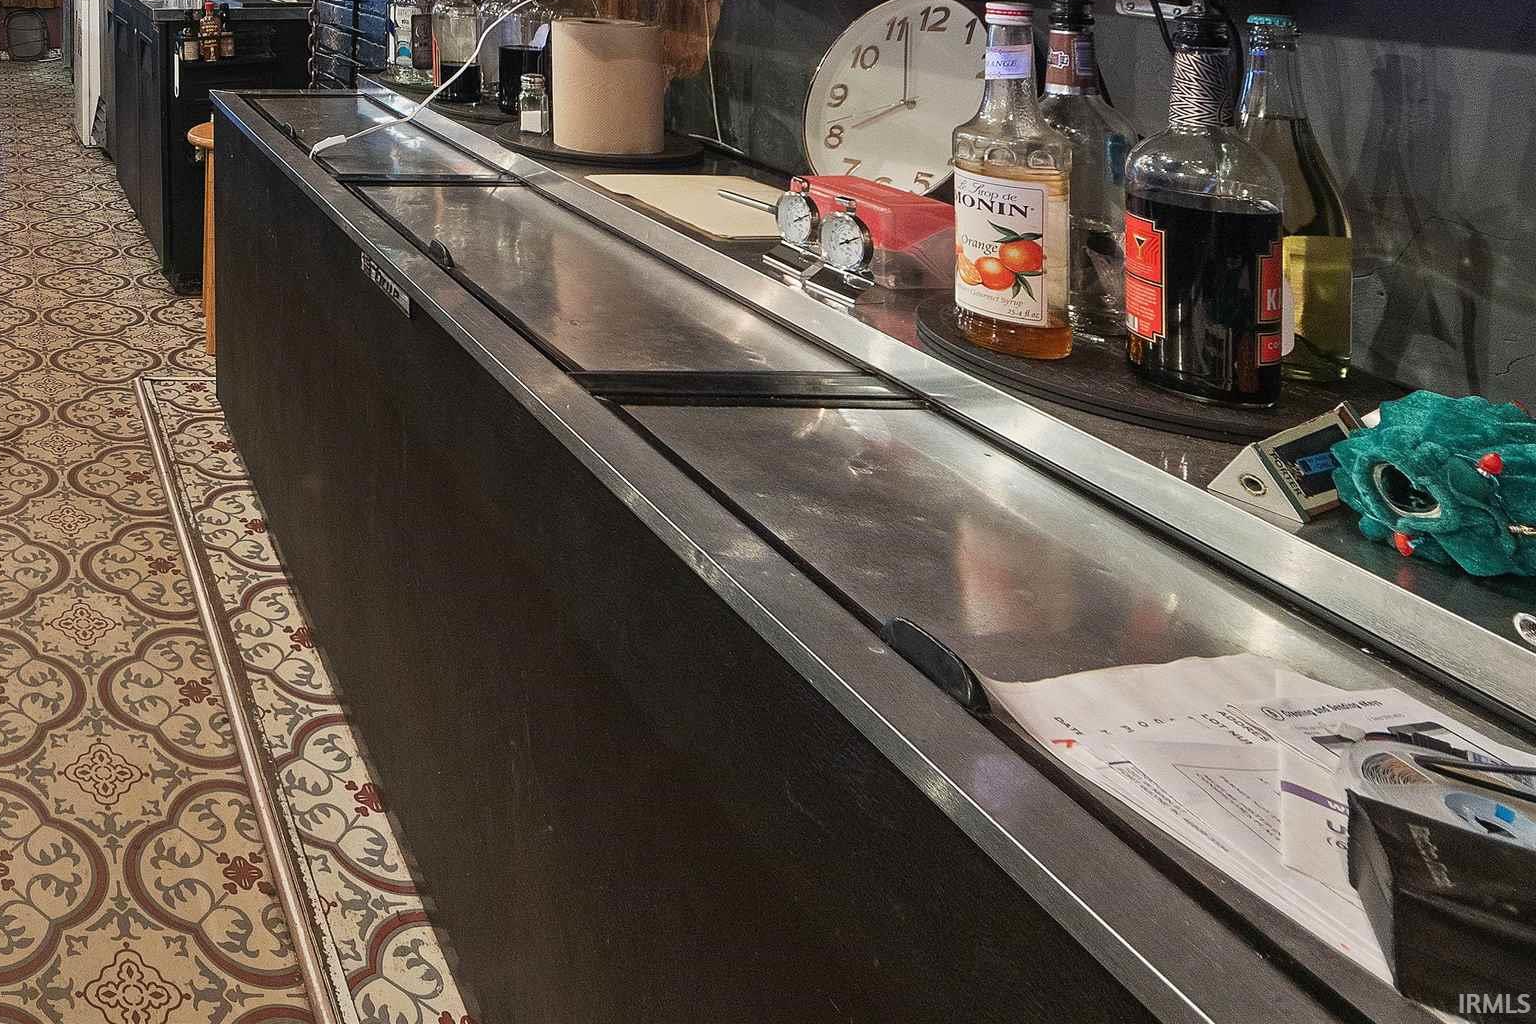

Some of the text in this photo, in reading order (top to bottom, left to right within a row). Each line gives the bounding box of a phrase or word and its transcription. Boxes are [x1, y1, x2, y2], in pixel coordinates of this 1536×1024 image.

[885, 15, 909, 42] 11
[920, 6, 951, 32] 12
[966, 18, 978, 45] 1
[850, 45, 880, 71] 10
[827, 83, 849, 108] 9
[824, 125, 844, 149] 8
[842, 157, 862, 177] 7
[913, 171, 934, 193] 5
[1002, 191, 1018, 202] de
[961, 234, 999, 257] Orange
